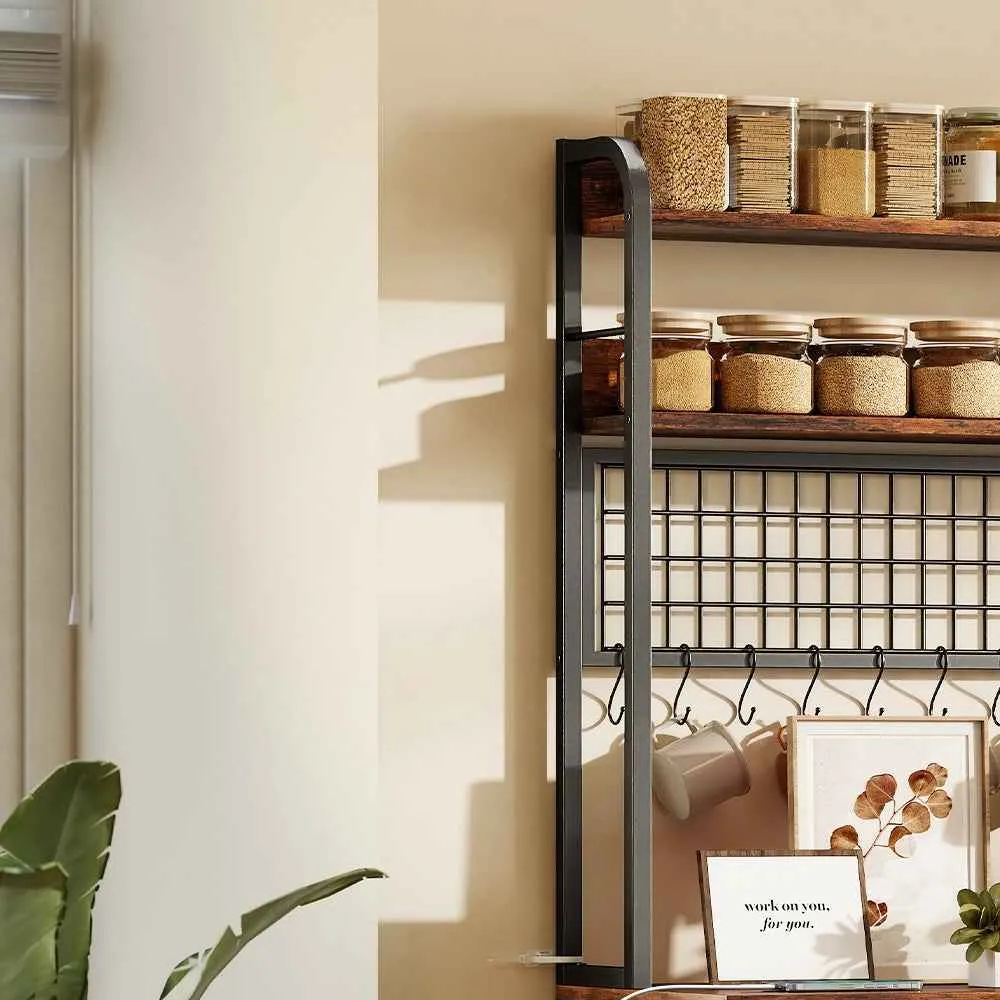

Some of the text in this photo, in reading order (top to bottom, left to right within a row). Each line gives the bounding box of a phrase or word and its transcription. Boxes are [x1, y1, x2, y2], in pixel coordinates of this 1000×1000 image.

[744, 900, 830, 914] work on you,
[760, 917, 814, 932] for you.
